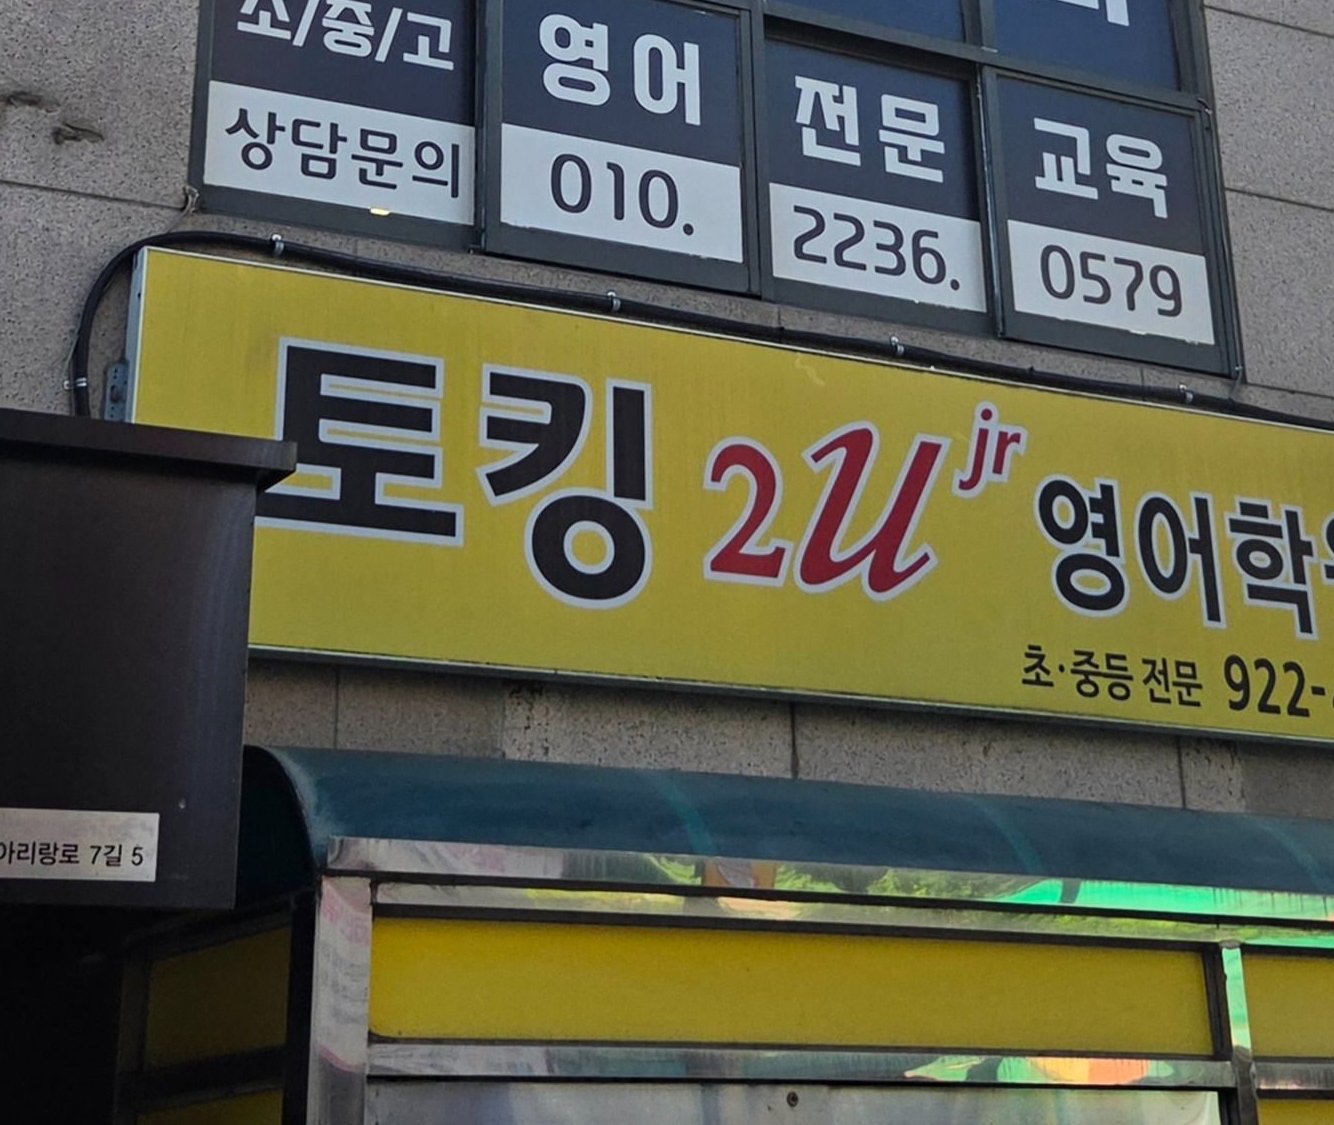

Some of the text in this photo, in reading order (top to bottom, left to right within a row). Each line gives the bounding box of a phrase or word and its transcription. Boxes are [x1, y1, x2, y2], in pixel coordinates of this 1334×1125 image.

[224, 107, 1183, 318] 상담문의 010. 2236. 0579
[539, 13, 702, 127] 영어
[794, 74, 946, 184] 전문
[1033, 117, 1168, 220] 교육
[255, 339, 652, 609] 토킹
[1141, 655, 1203, 708] 전문
[89, 844, 123, 867] 7길
[131, 846, 144, 866] 5
